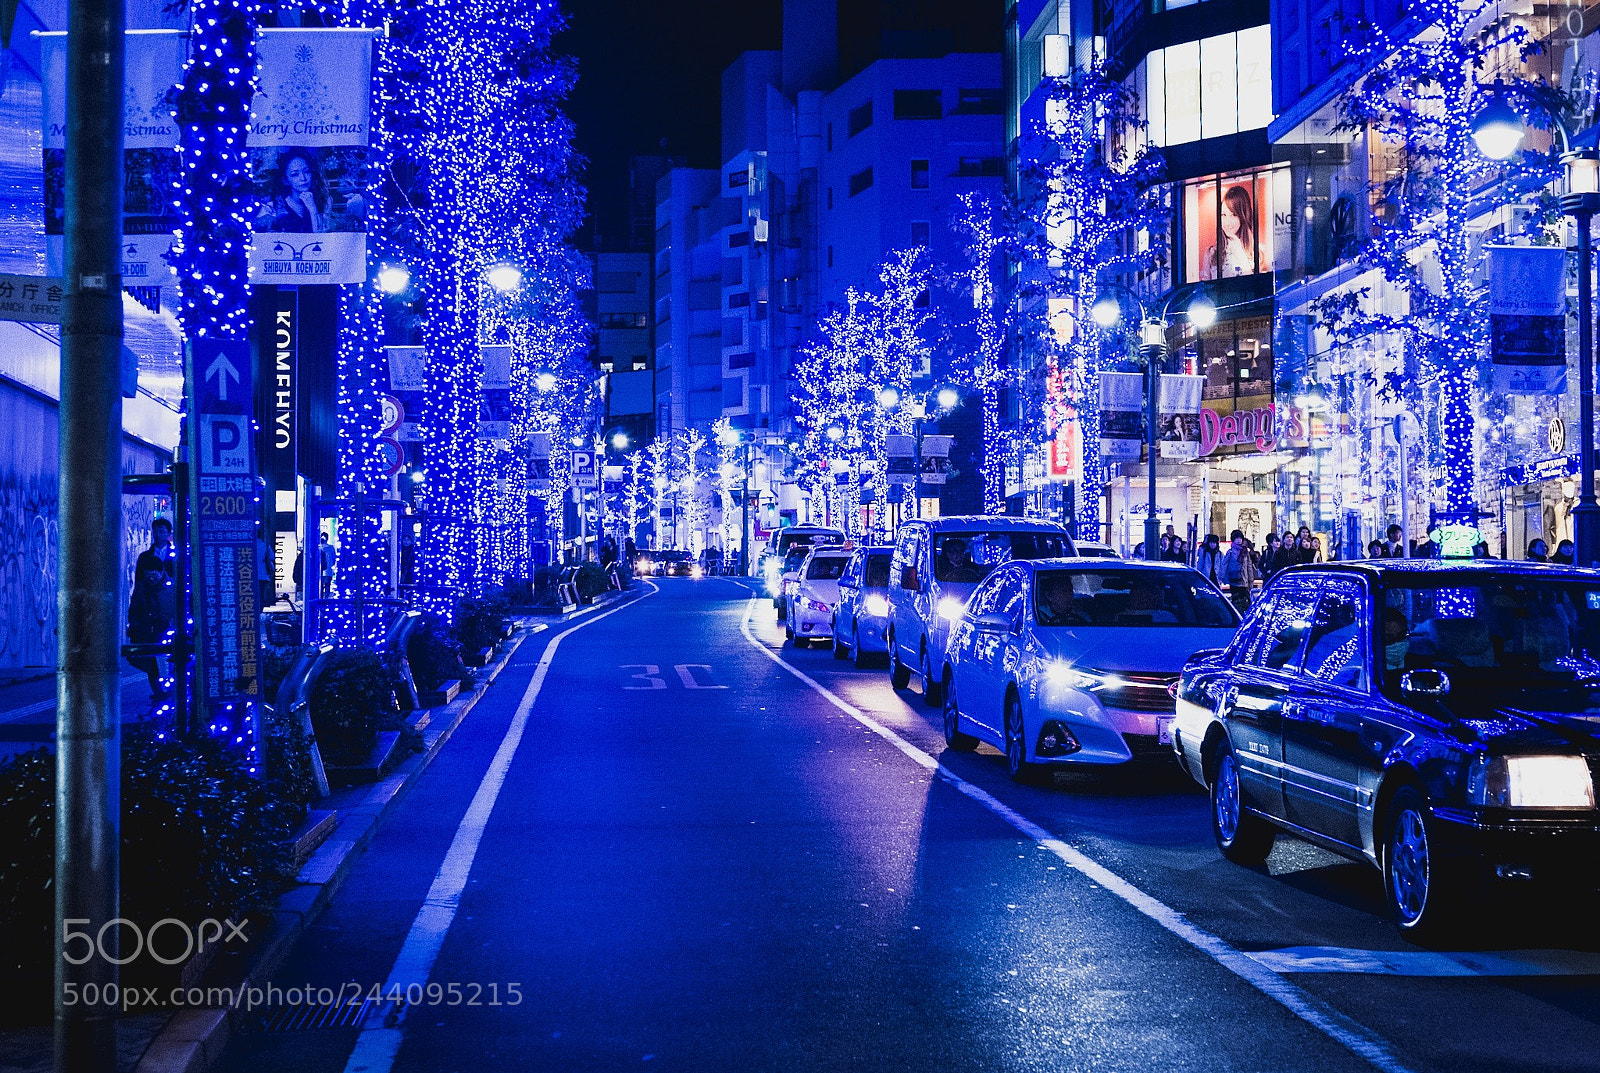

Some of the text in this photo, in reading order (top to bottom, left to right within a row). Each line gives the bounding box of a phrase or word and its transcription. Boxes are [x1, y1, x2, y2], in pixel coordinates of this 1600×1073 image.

[250, 119, 363, 140] Merry Christmas
[264, 261, 330, 273] SHIBUYA KOEN DORI
[275, 310, 291, 449] KOMEHYO
[212, 421, 240, 467] P
[224, 457, 245, 468] 24H
[575, 453, 590, 473] P
[1444, 531, 1477, 541] グリーン
